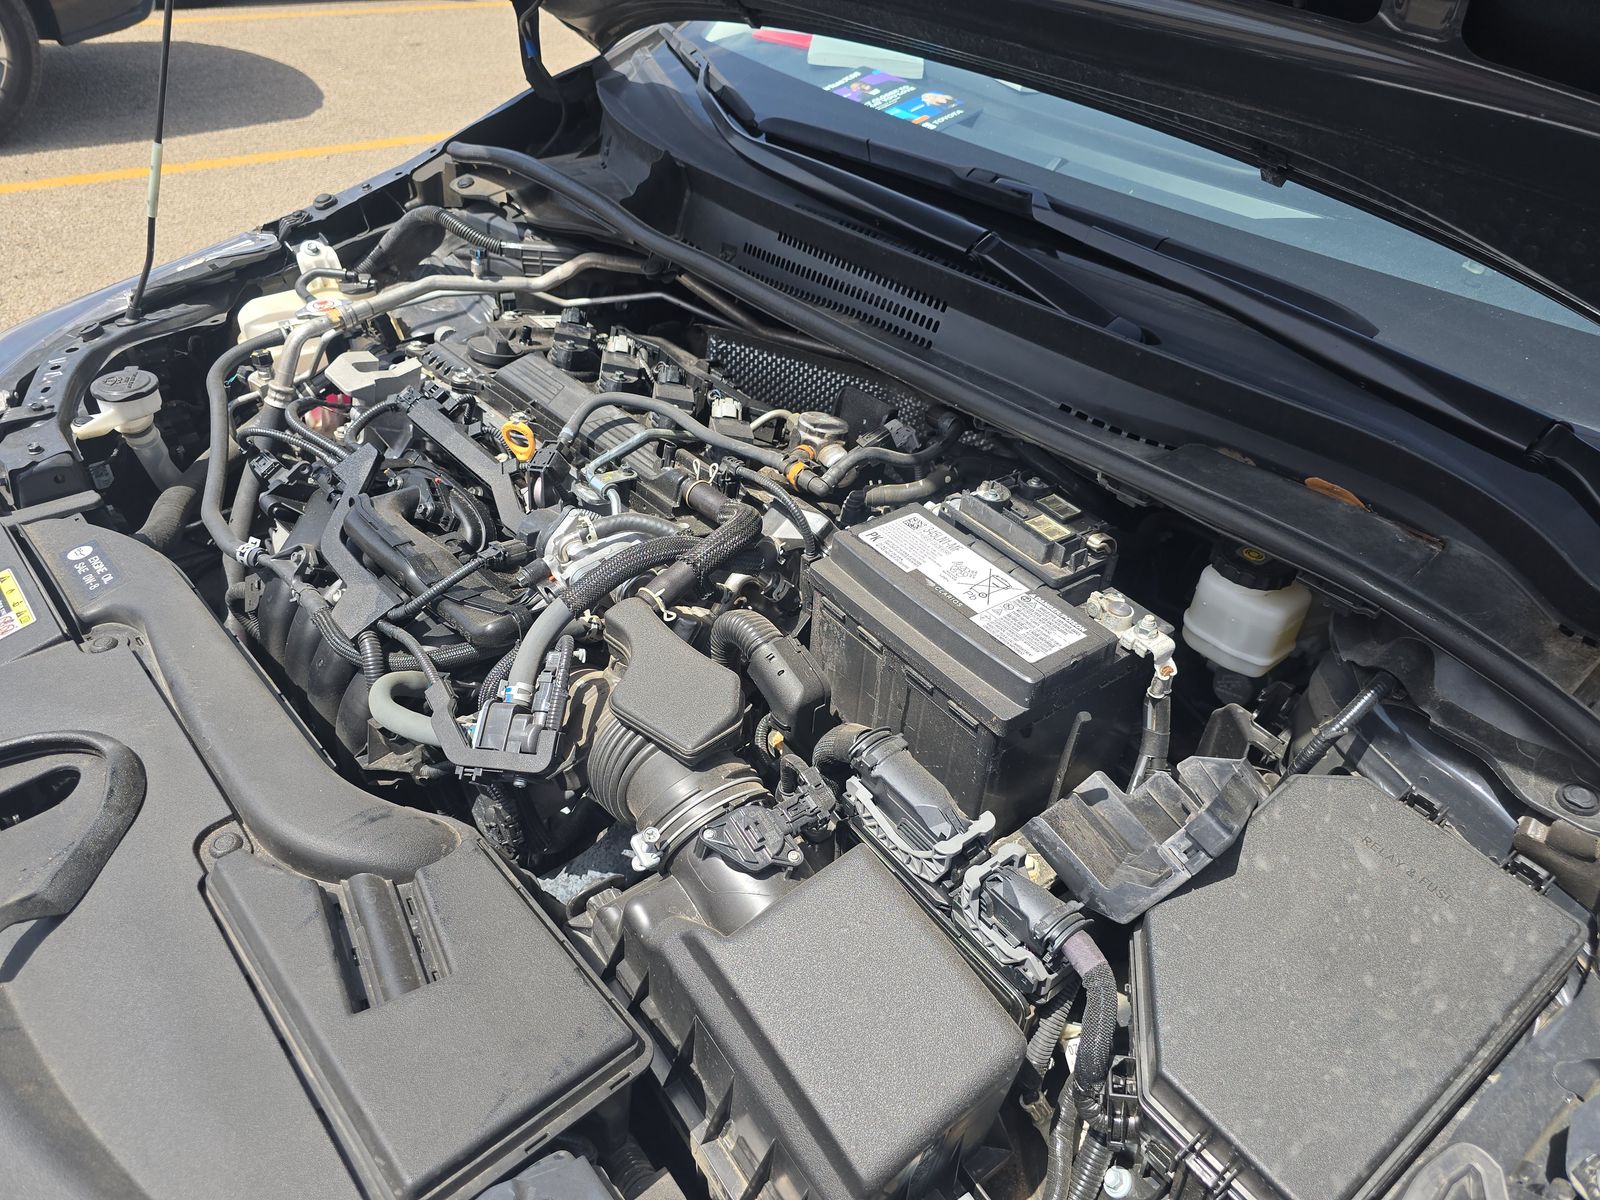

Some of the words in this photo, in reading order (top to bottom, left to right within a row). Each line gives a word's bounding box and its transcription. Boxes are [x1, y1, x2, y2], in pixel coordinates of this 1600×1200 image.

[932, 110, 964, 125] TOYOTA
[865, 531, 883, 544] PK
[934, 586, 963, 608] CLARIOS
[962, 590, 977, 601] Pb
[1362, 835, 1406, 868] RELAY
[1406, 868, 1416, 878] &
[1419, 876, 1455, 906] FUSE
